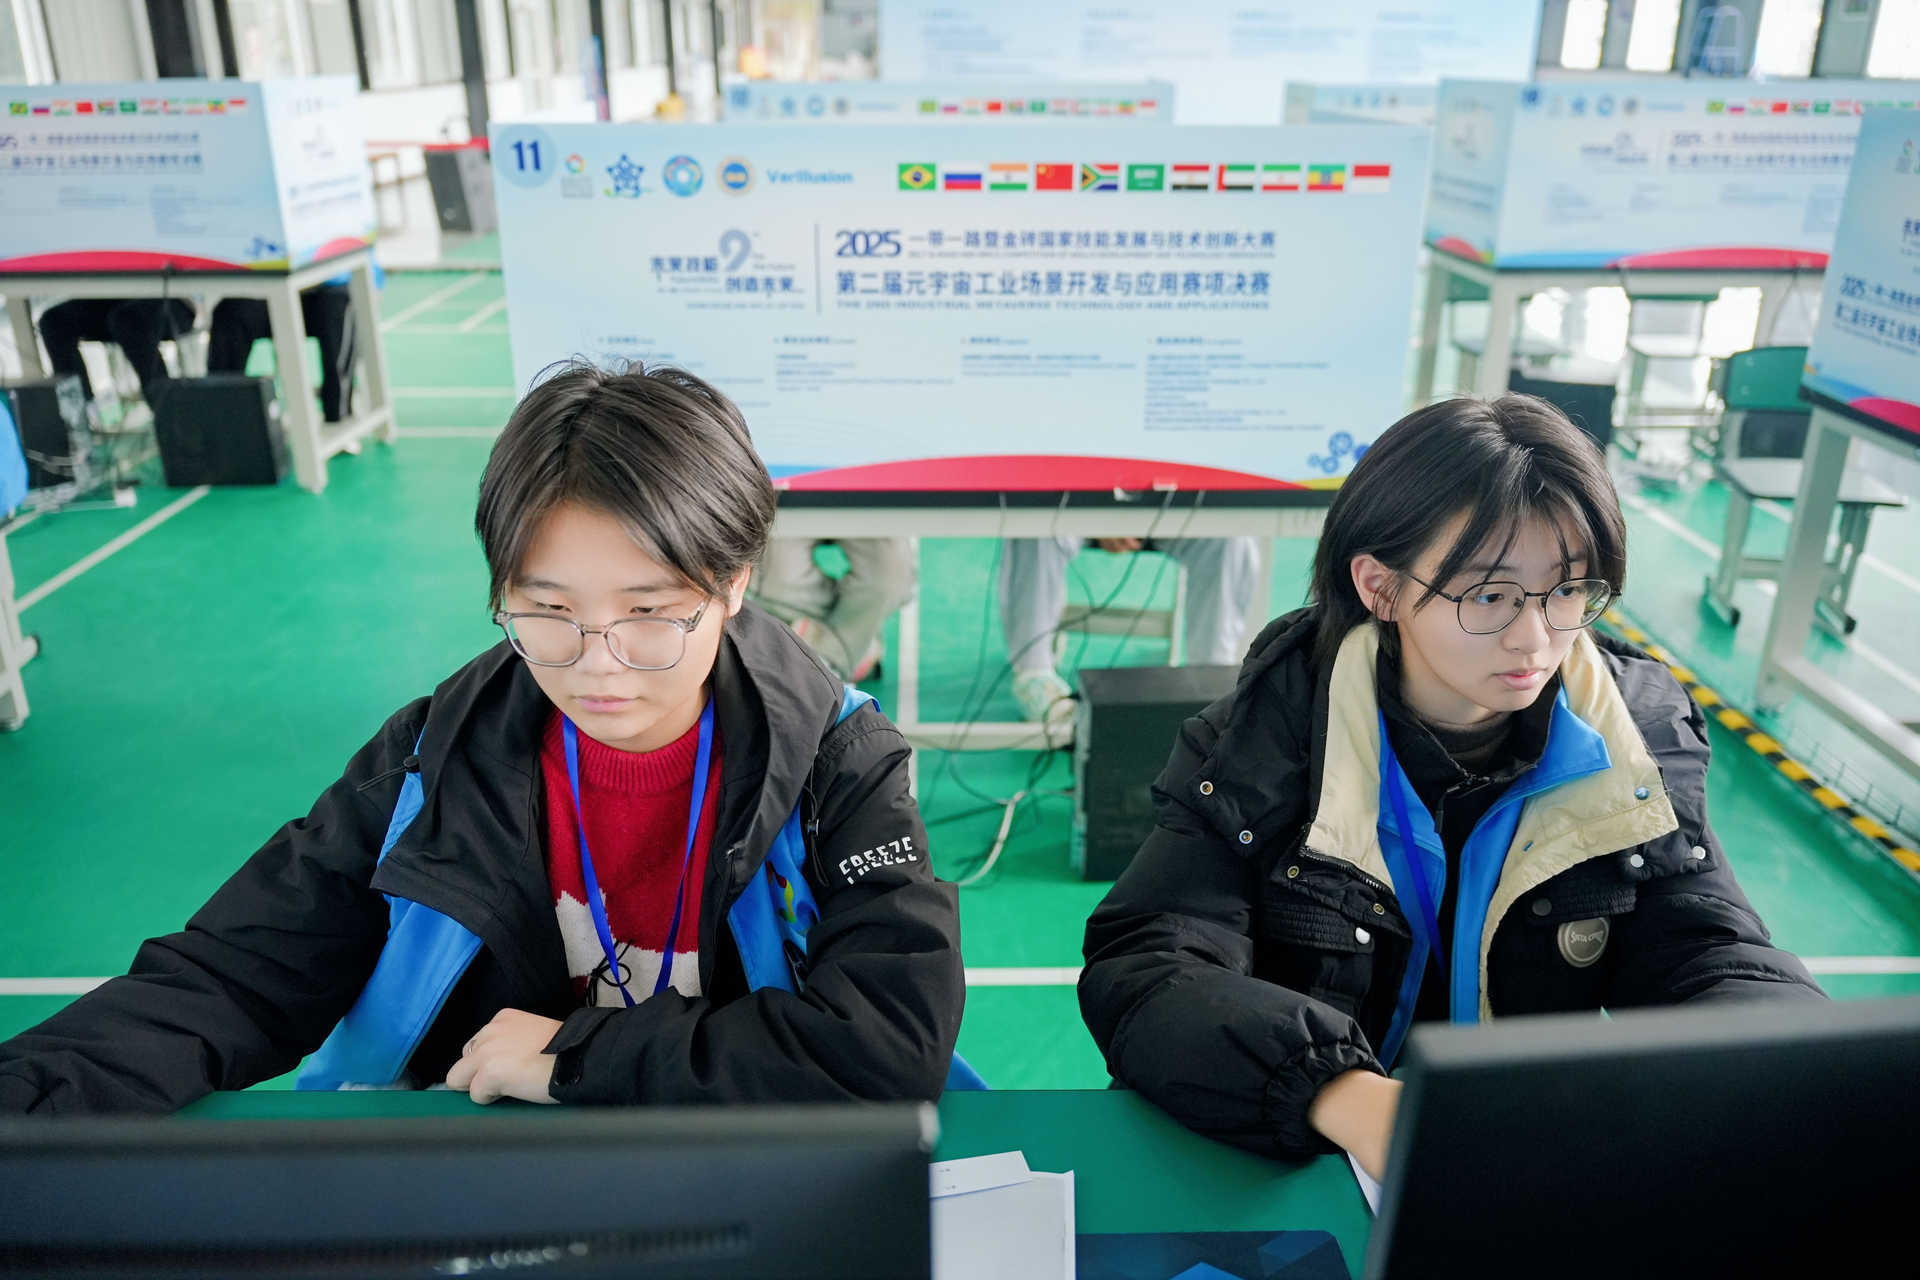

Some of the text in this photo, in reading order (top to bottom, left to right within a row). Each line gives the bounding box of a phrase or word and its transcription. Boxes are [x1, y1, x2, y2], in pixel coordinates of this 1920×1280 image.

[512, 141, 541, 171] 11
[835, 230, 902, 257] 2025
[837, 270, 1270, 296] 第二届元宇宙工业场景开发与应用赛项决赛
[839, 836, 917, 885] FREEZE
